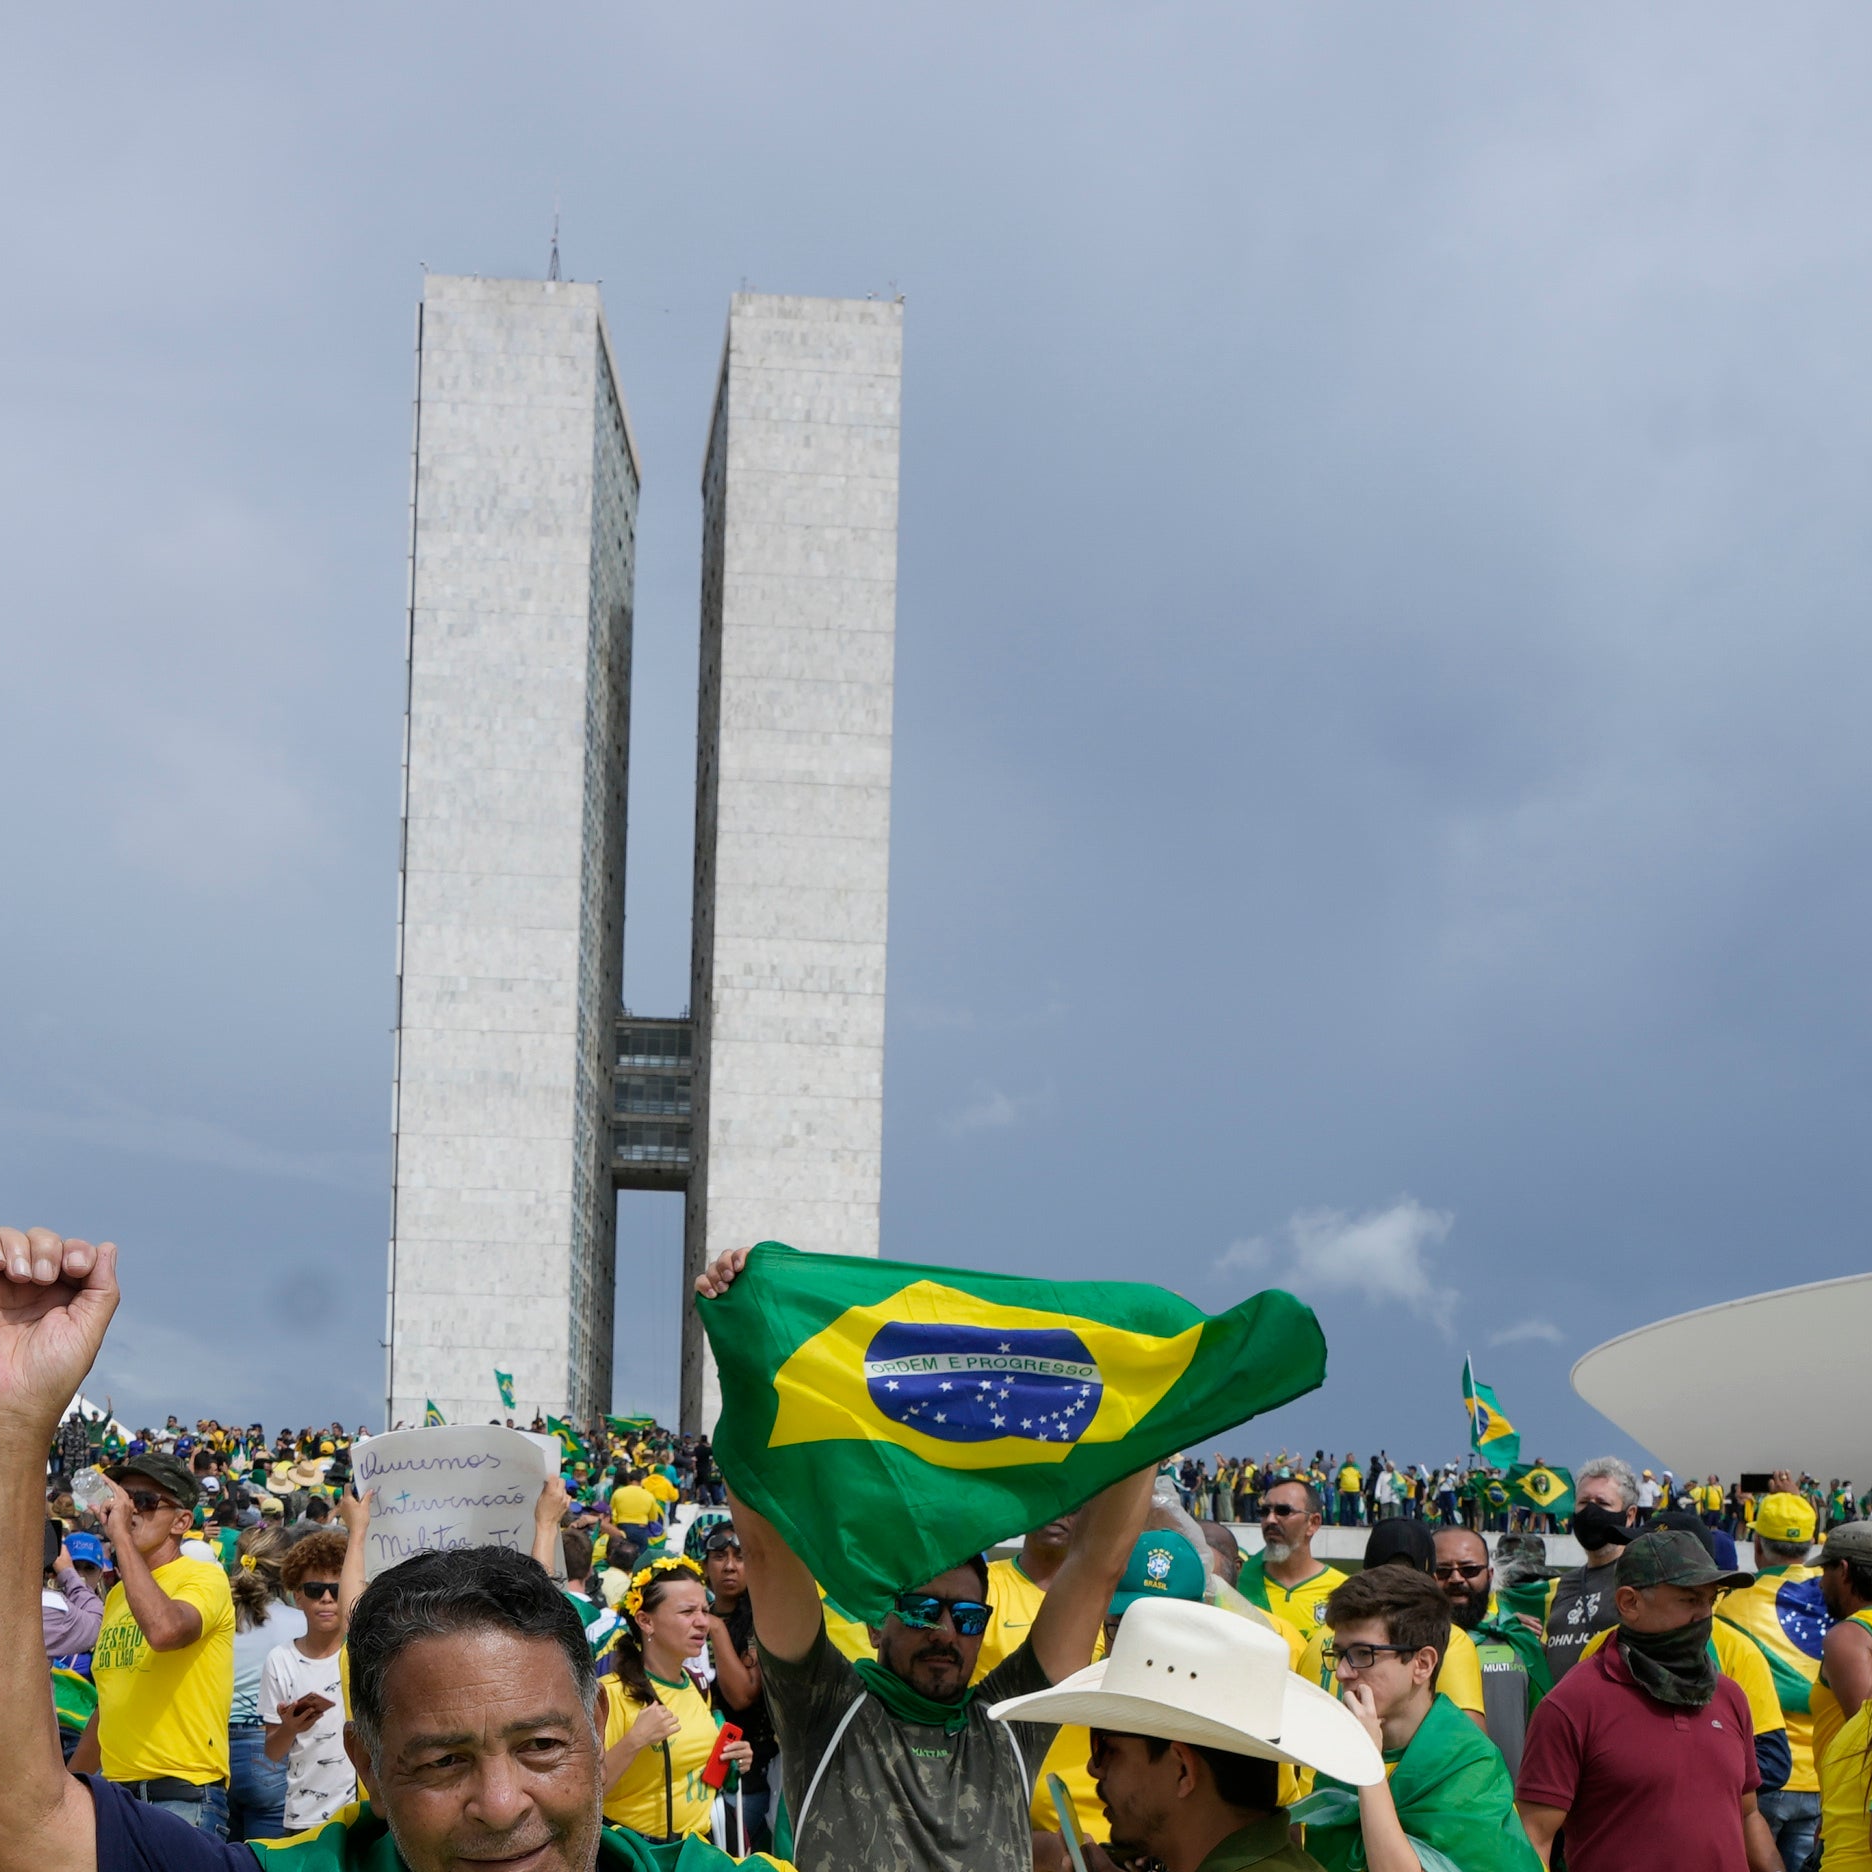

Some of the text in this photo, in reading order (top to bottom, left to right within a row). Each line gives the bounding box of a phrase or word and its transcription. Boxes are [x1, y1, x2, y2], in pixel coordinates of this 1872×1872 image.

[871, 1356, 1093, 1377] ORDEM E PROGRESSO
[360, 1451, 501, 1481] Queremos
[369, 1484, 526, 1518] Intervenção
[371, 1521, 473, 1561] Militar
